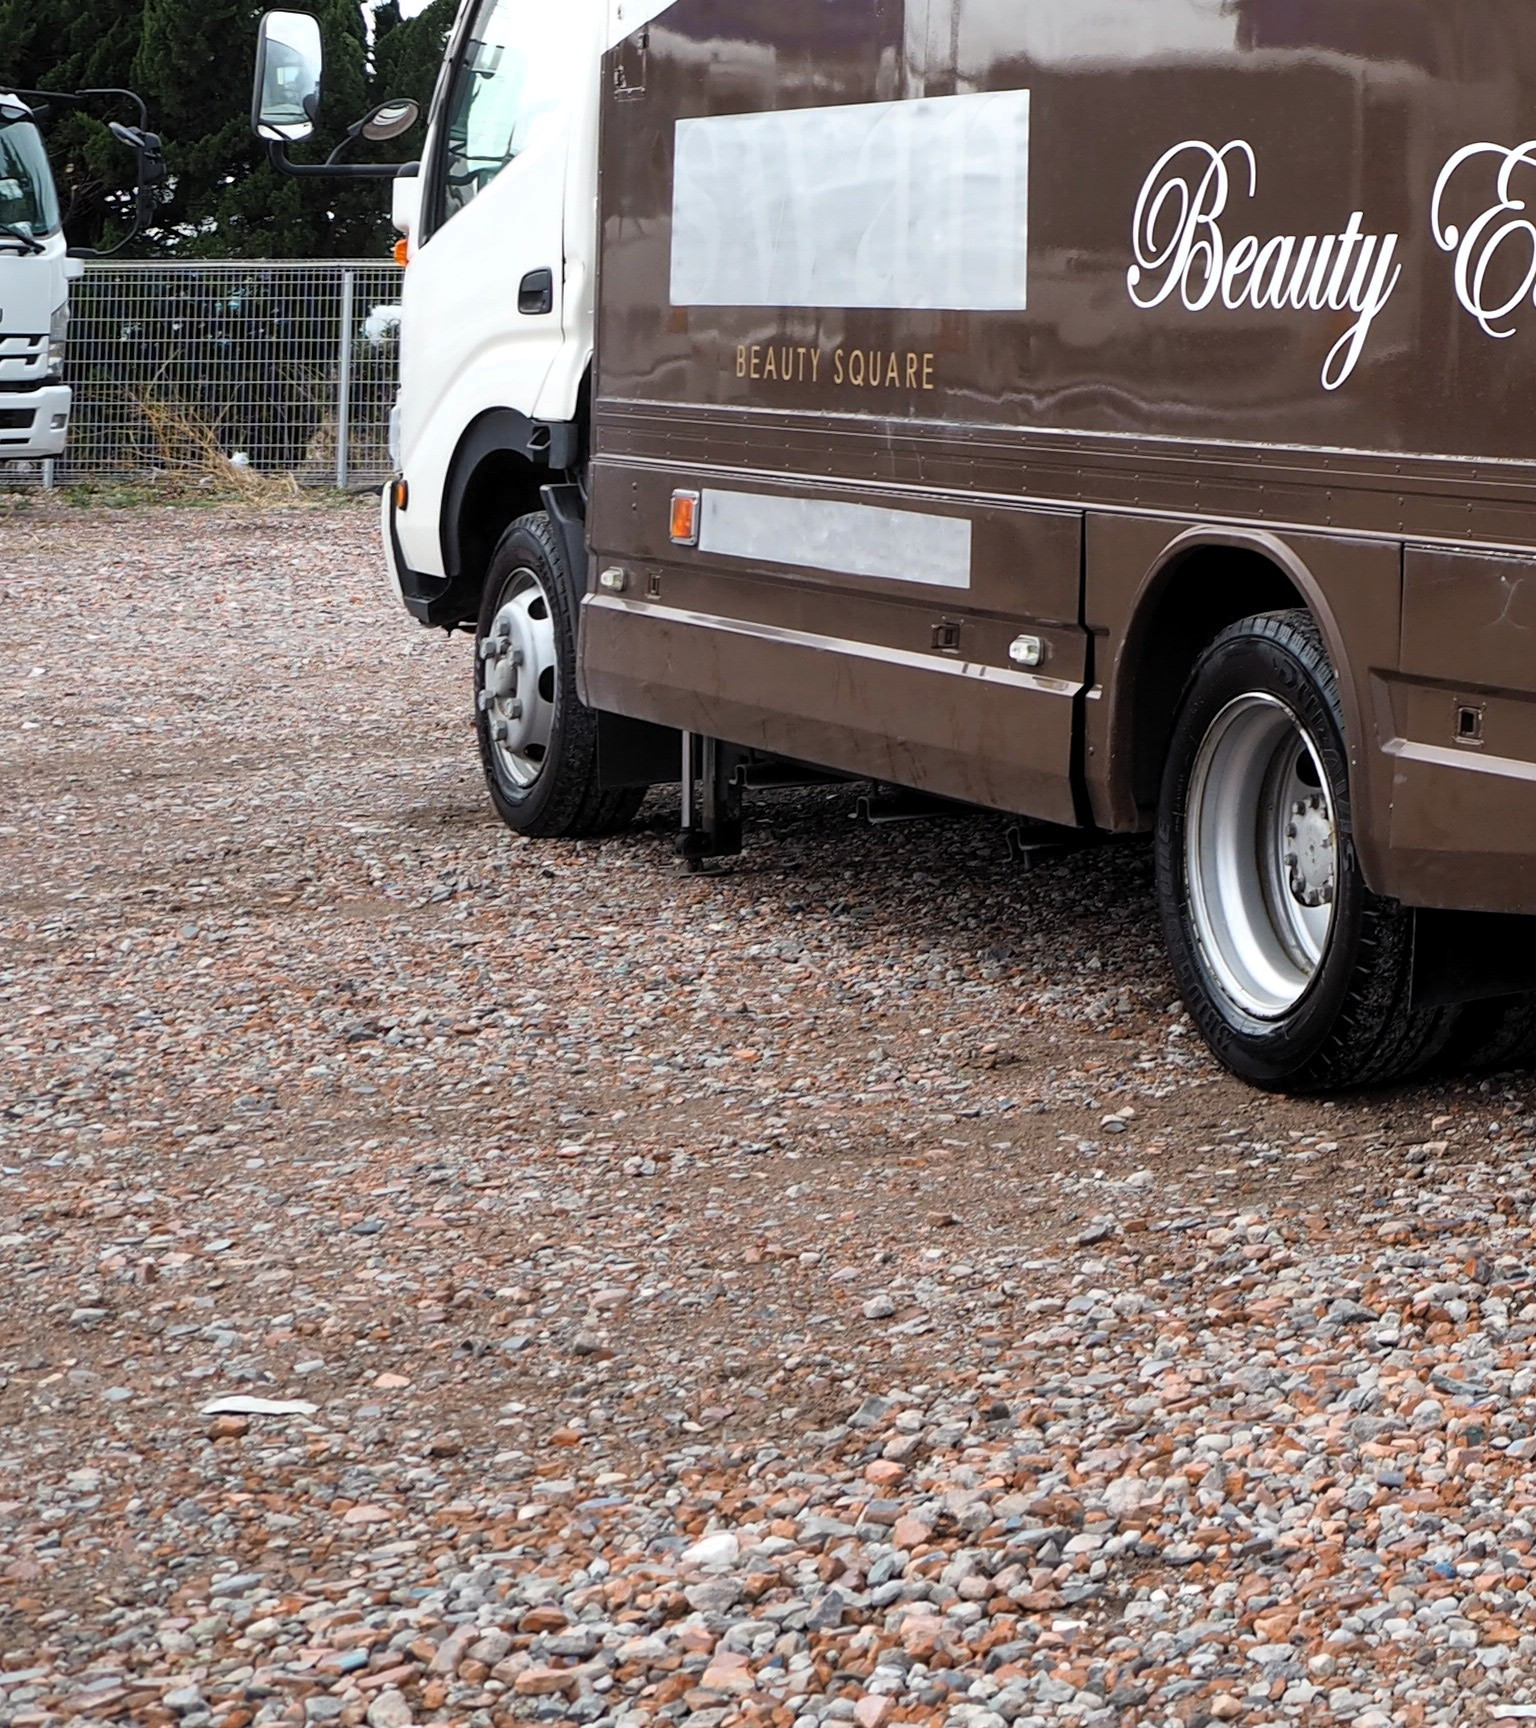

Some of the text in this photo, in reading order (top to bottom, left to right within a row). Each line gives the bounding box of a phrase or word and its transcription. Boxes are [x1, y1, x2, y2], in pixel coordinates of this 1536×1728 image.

[1127, 139, 1402, 391] Beauty
[736, 344, 934, 390] BEAUTY SQUARE
